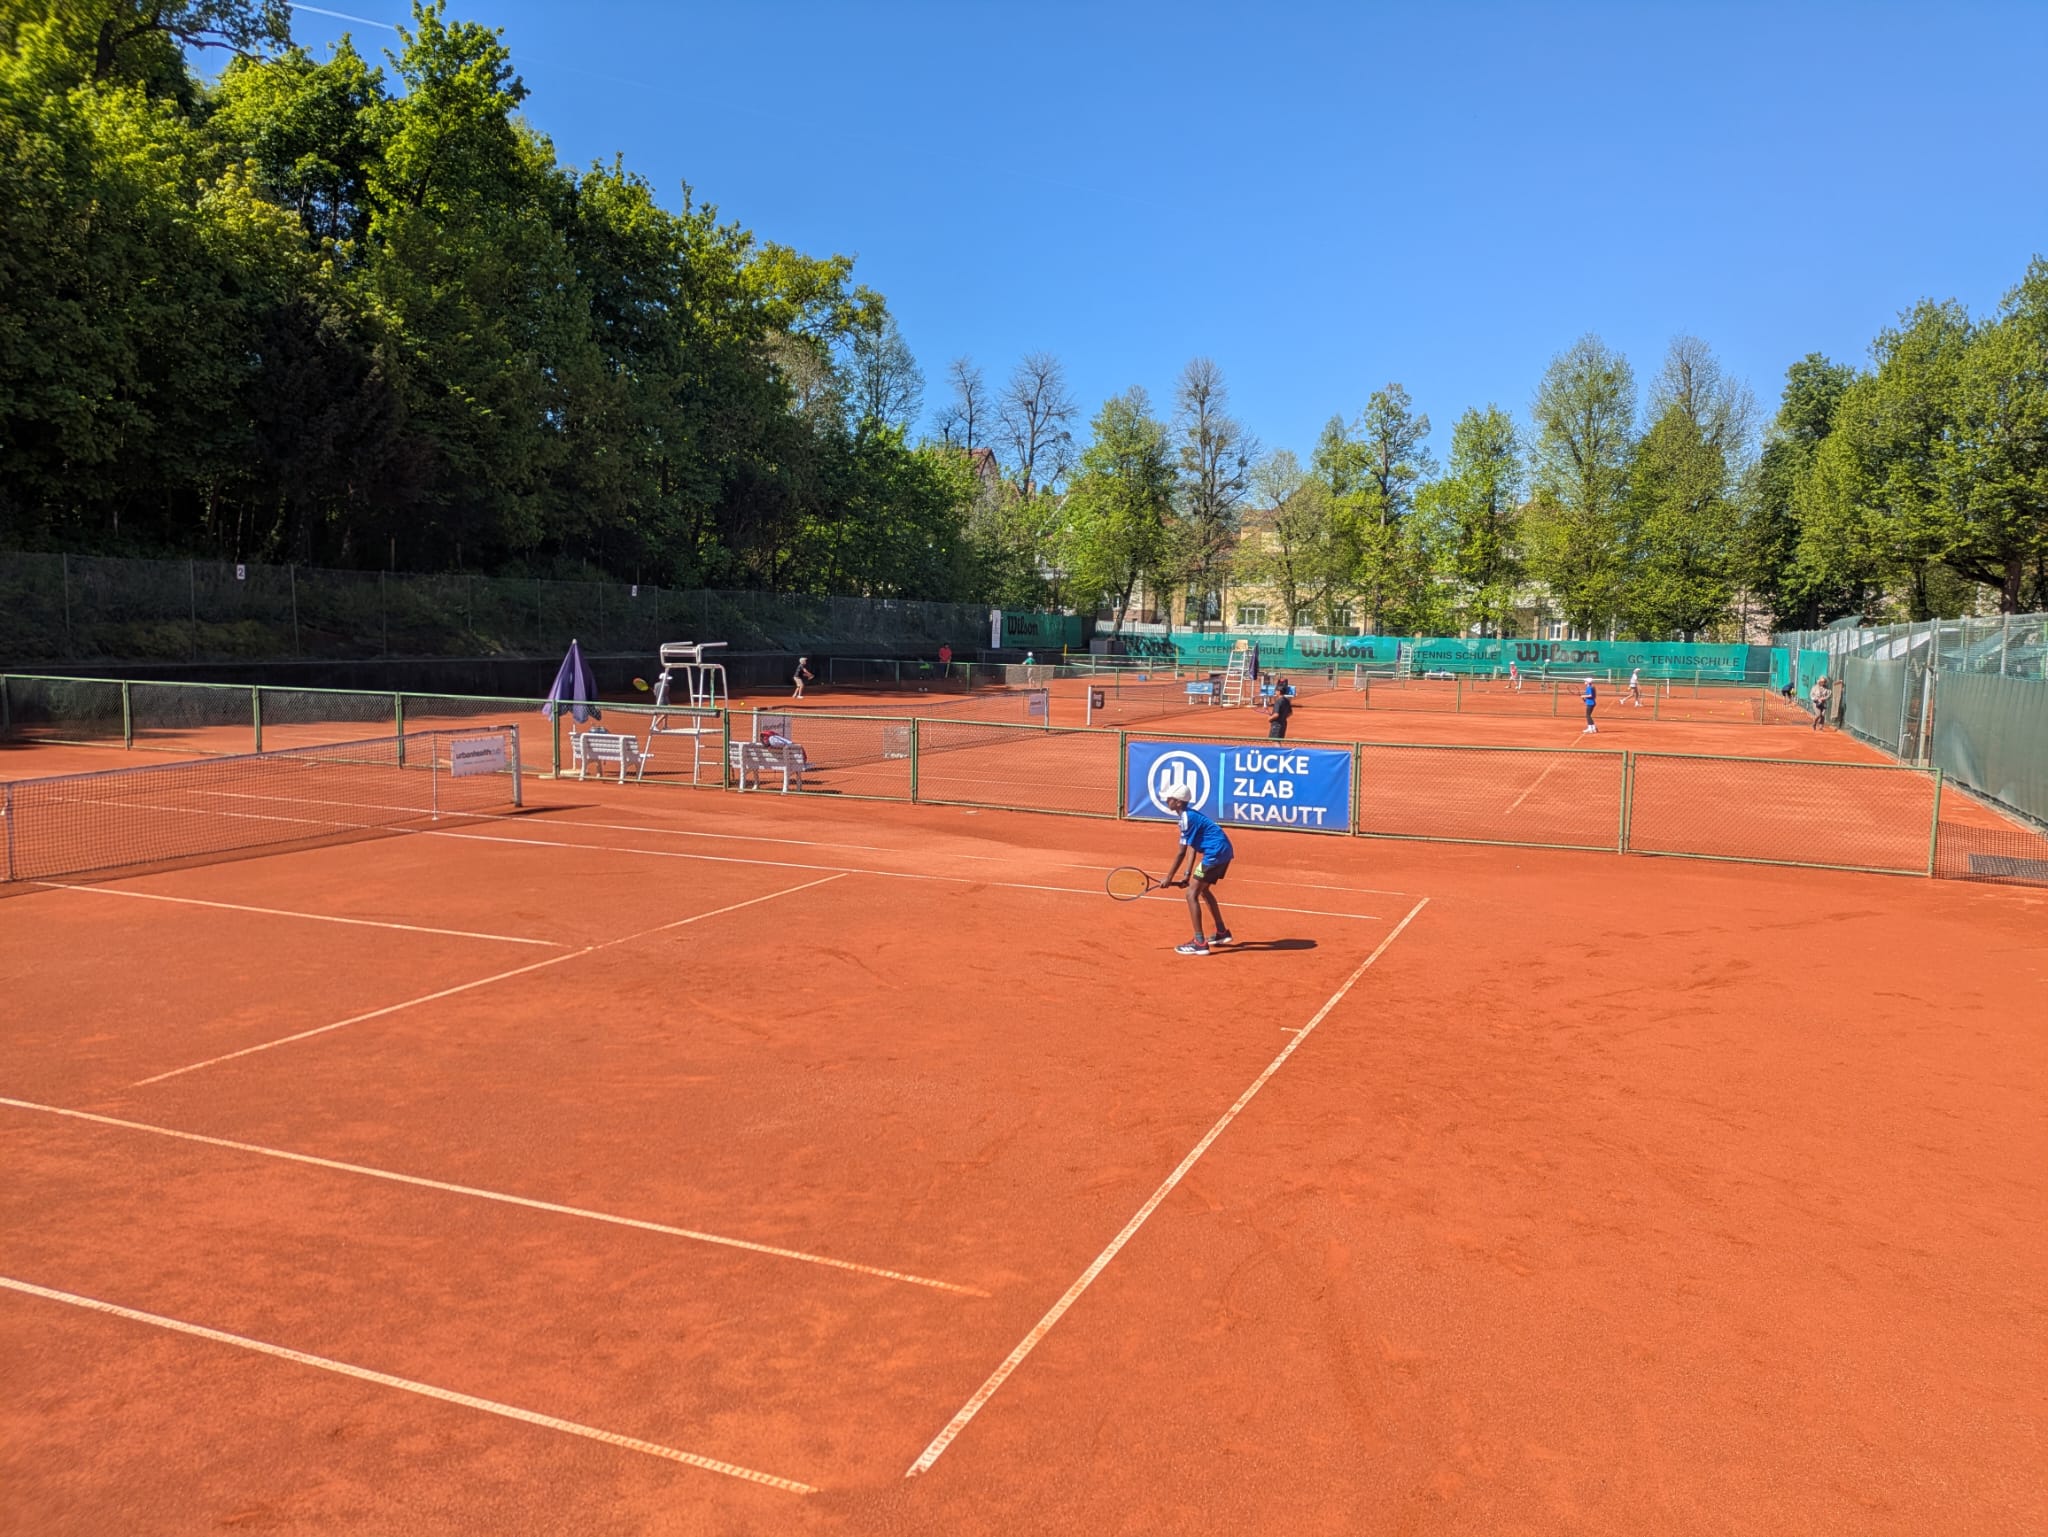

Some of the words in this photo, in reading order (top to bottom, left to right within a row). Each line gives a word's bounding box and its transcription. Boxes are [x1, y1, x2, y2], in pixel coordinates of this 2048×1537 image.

[1007, 615, 1039, 636] Wilson
[1300, 638, 1377, 659] Wilson
[1416, 650, 1453, 660] TENNIS
[1455, 651, 1498, 661] SCHULE
[1515, 642, 1600, 664] Wilson
[1627, 654, 1644, 665] GC
[1650, 655, 1740, 667] TENNISSCHULE
[1234, 750, 1310, 775] LÜCKE
[1233, 777, 1294, 799] ZLAB
[1233, 803, 1327, 825] KRAUTT
